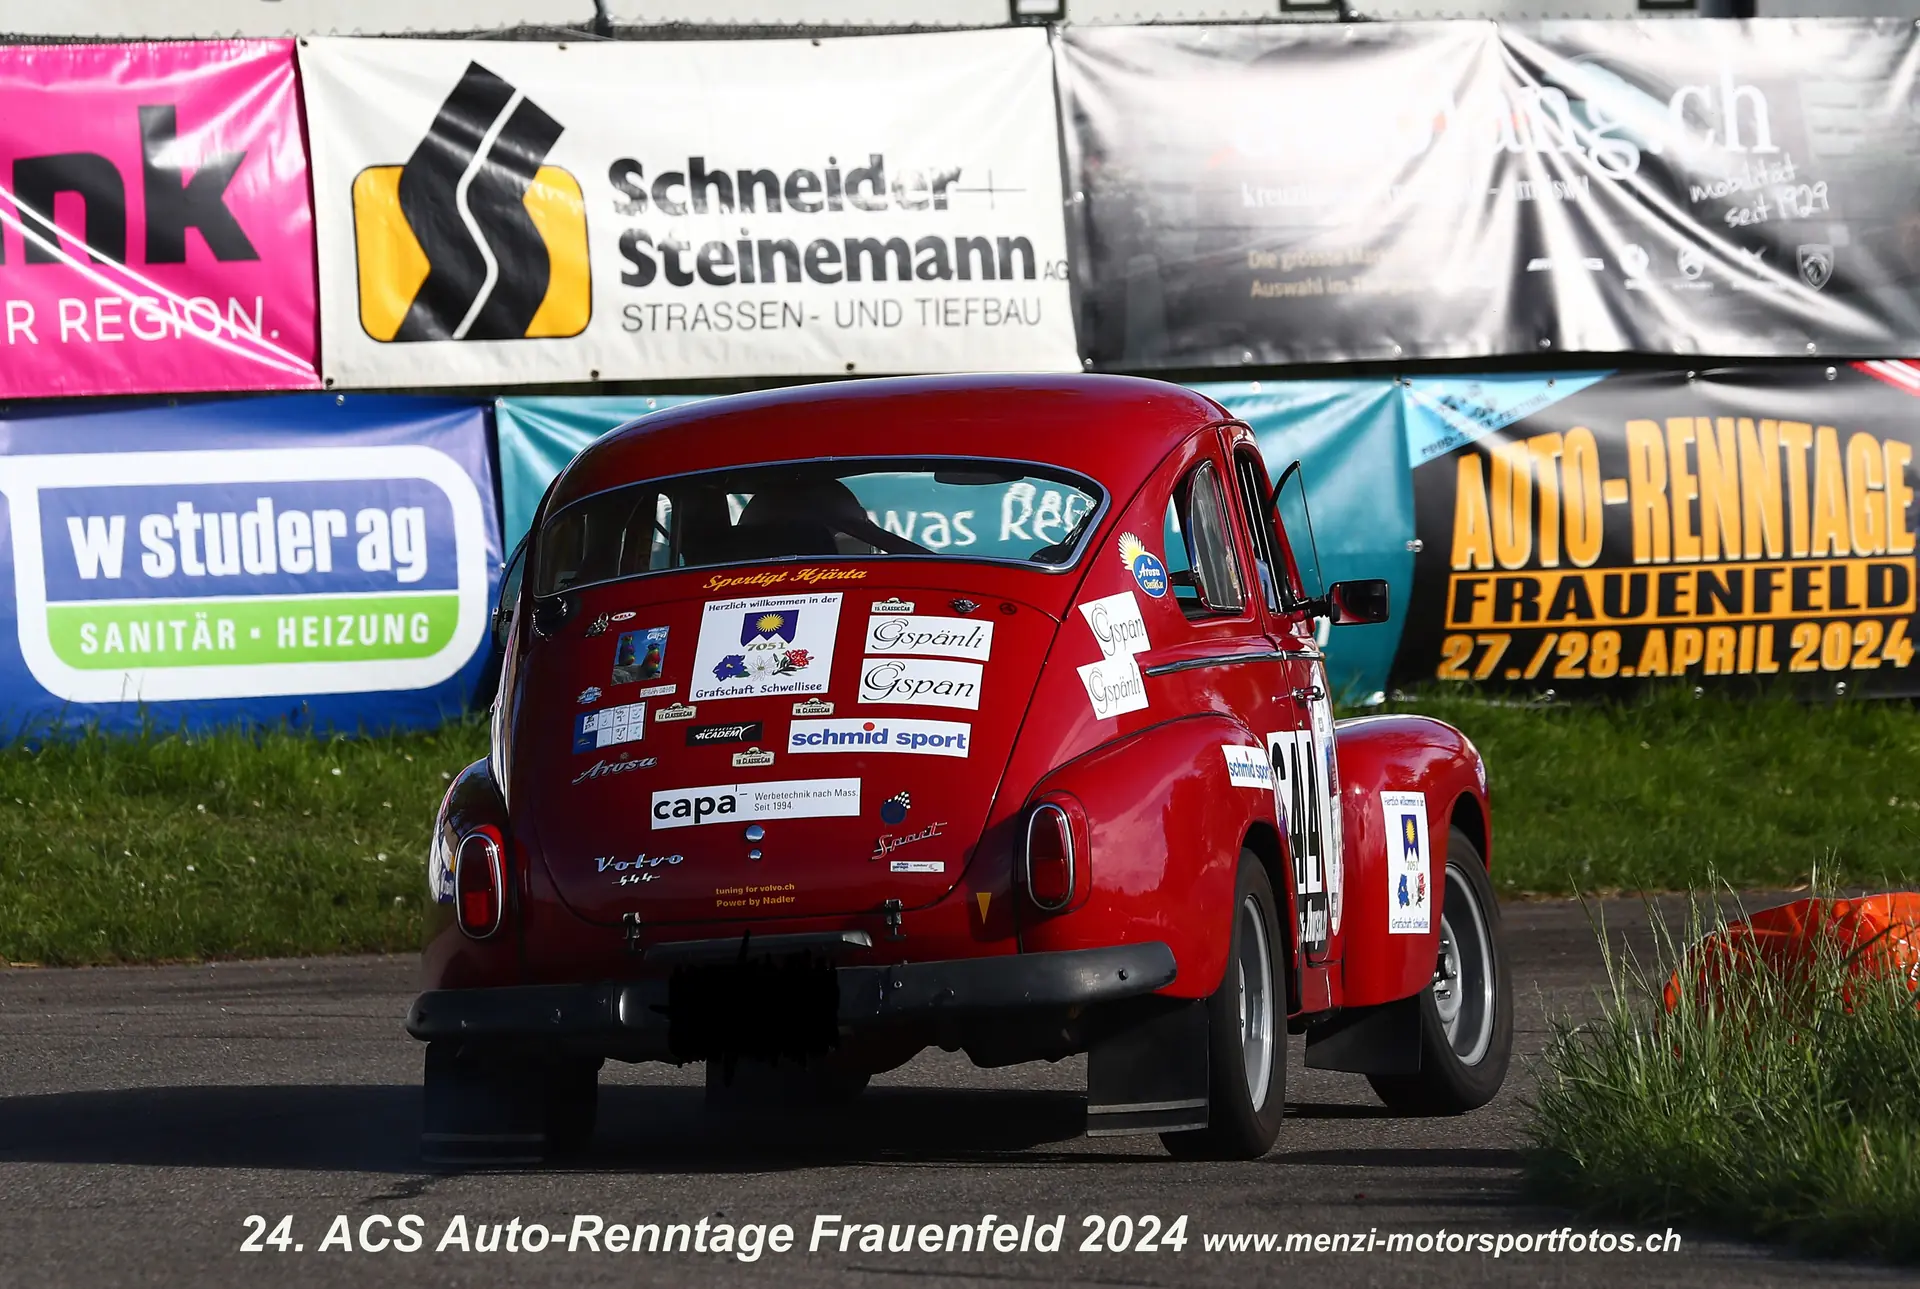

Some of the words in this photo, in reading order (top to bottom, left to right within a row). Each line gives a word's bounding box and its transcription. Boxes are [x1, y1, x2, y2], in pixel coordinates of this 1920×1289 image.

[0, 105, 260, 266] nk
[608, 154, 962, 216] Schneider
[1690, 152, 1798, 203] mobilität
[1724, 197, 1770, 229] seit
[1776, 180, 1830, 219] 1929
[619, 228, 1036, 288] Steinemann
[1043, 259, 1070, 281] AG
[60, 296, 279, 342] REGION.
[834, 298, 903, 328] UND
[919, 297, 1042, 327] TIEFBAU
[1452, 416, 1917, 570] AUTO-RENNTAGE
[140, 497, 347, 578] studer
[356, 506, 430, 583] ag
[866, 509, 978, 549] was
[703, 571, 788, 590] Sportigt
[790, 568, 869, 584] Hjärta
[1453, 562, 1911, 624] FRAUENFELD
[708, 601, 747, 612] Herzlich
[750, 598, 806, 609] willkommen
[809, 596, 818, 604] in
[821, 595, 838, 604] der
[80, 612, 237, 654] SANITÄR
[277, 612, 430, 648] HEIZUNG
[747, 642, 786, 652] 7051
[871, 617, 985, 650] Gspänli
[1091, 602, 1144, 657] Gspan
[1789, 618, 1917, 673] 2024
[695, 684, 755, 699] Grafschaft
[760, 681, 823, 694] Schwellisee
[862, 661, 975, 700] Gspan
[1088, 662, 1141, 714] Gspänli
[791, 721, 889, 746] schmid
[896, 732, 967, 750] sport
[653, 793, 737, 824] capa
[754, 802, 770, 811] Seit
[755, 790, 811, 801] Werbetechnik
[813, 788, 832, 798] nach
[834, 787, 858, 797] Mass.
[872, 822, 947, 860] Sport
[595, 854, 684, 872] Volvo
[617, 872, 655, 886] 544
[716, 886, 743, 896] tuning
[745, 885, 758, 893] for
[760, 883, 795, 892] volvo.ch
[716, 898, 746, 907] Power
[749, 897, 761, 907] by
[763, 895, 795, 905] Nadler
